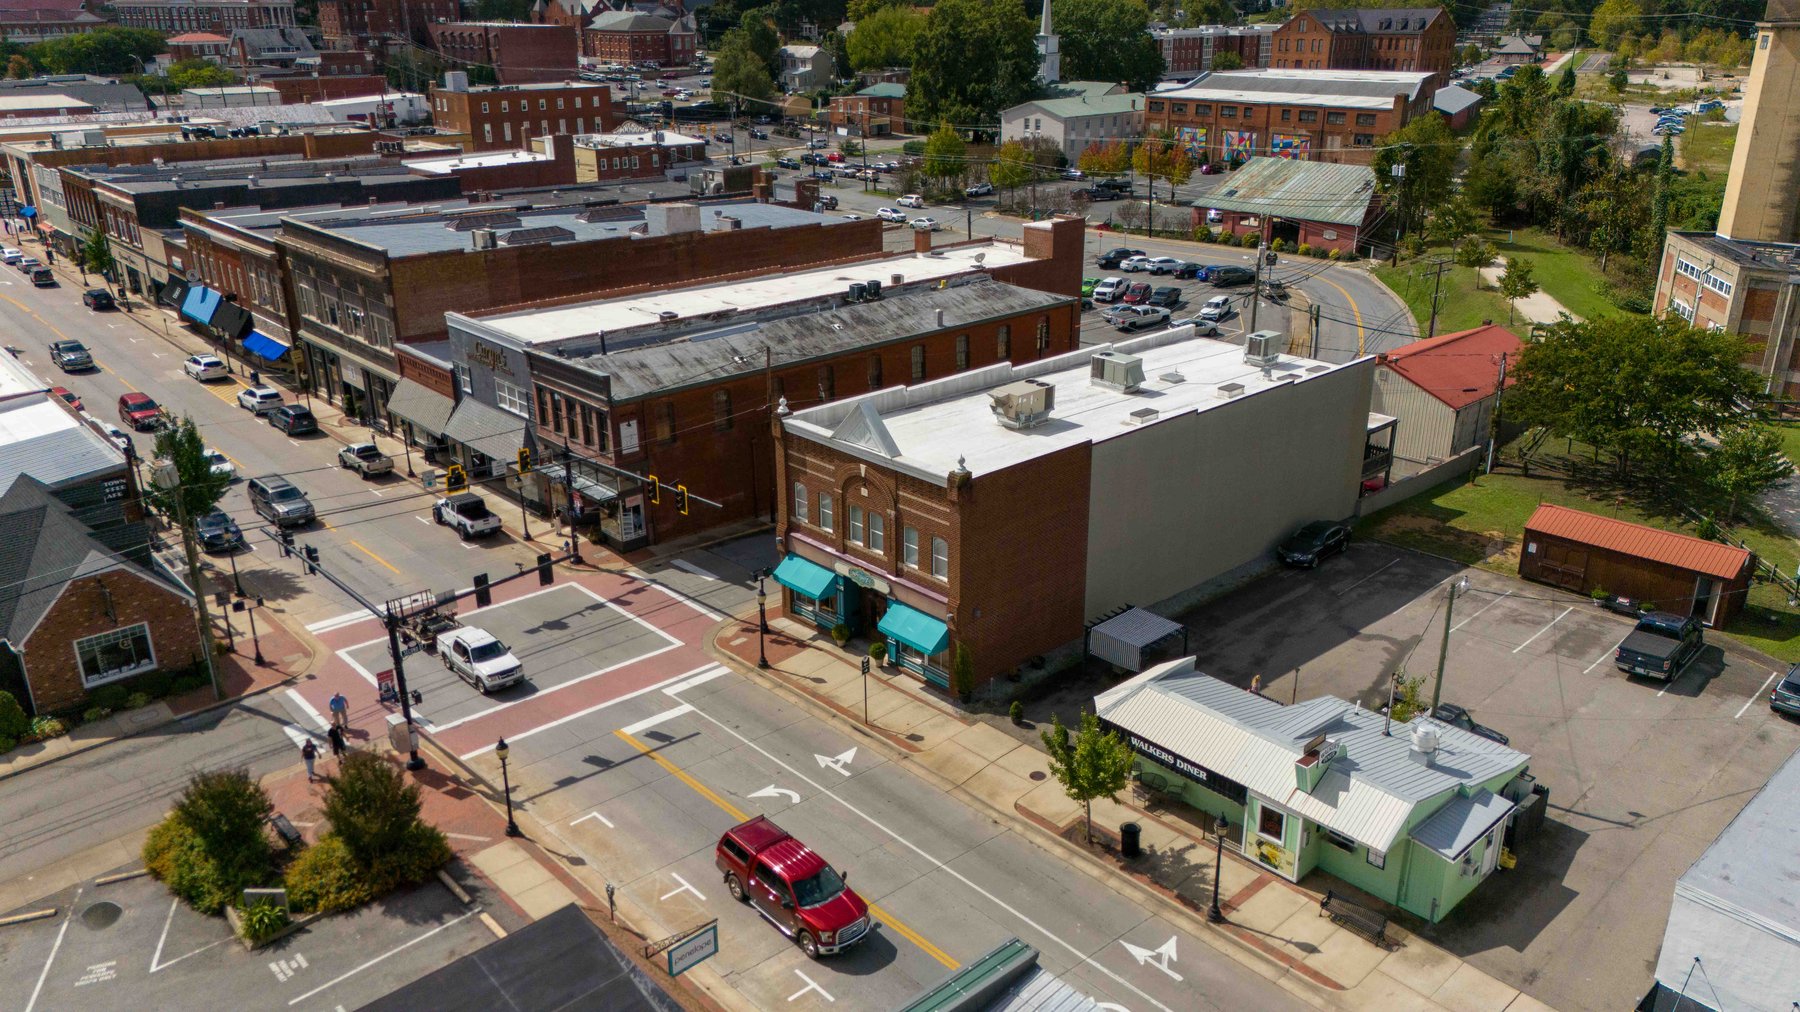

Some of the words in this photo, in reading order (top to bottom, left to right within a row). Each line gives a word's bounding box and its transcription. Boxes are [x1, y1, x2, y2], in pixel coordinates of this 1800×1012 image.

[1130, 736, 1175, 764] WALKERS
[1176, 758, 1208, 780] DINER
[674, 939, 712, 966] penelope
